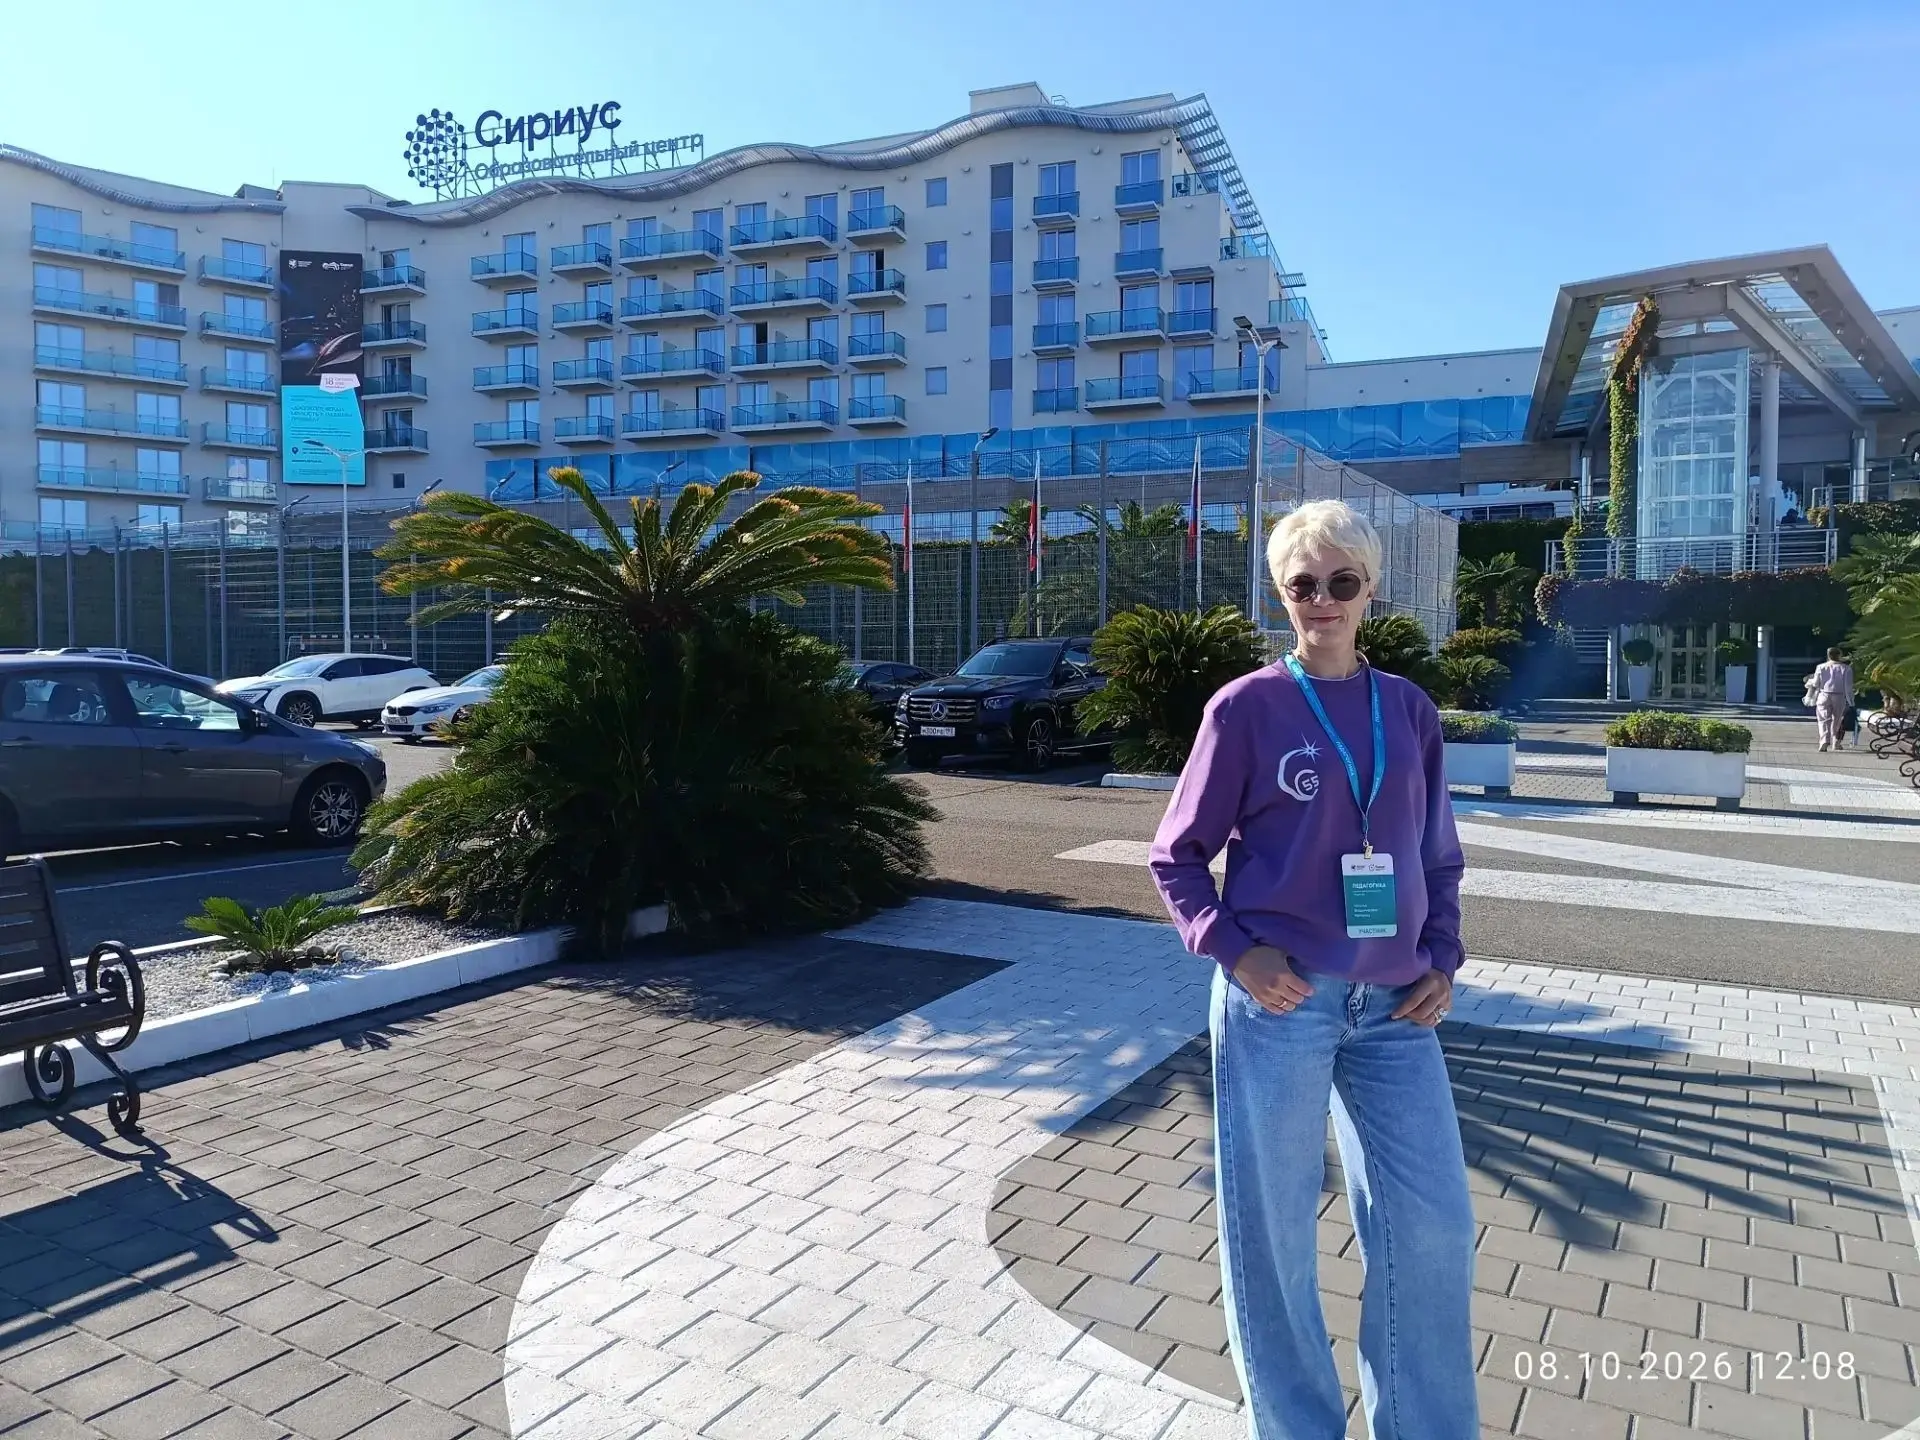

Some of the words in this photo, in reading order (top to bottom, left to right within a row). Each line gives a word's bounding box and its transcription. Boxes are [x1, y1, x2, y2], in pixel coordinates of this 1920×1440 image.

[475, 101, 622, 151] Сириус
[475, 140, 639, 180] Образовательный
[644, 132, 703, 156] центр
[1302, 775, 1319, 792] 55
